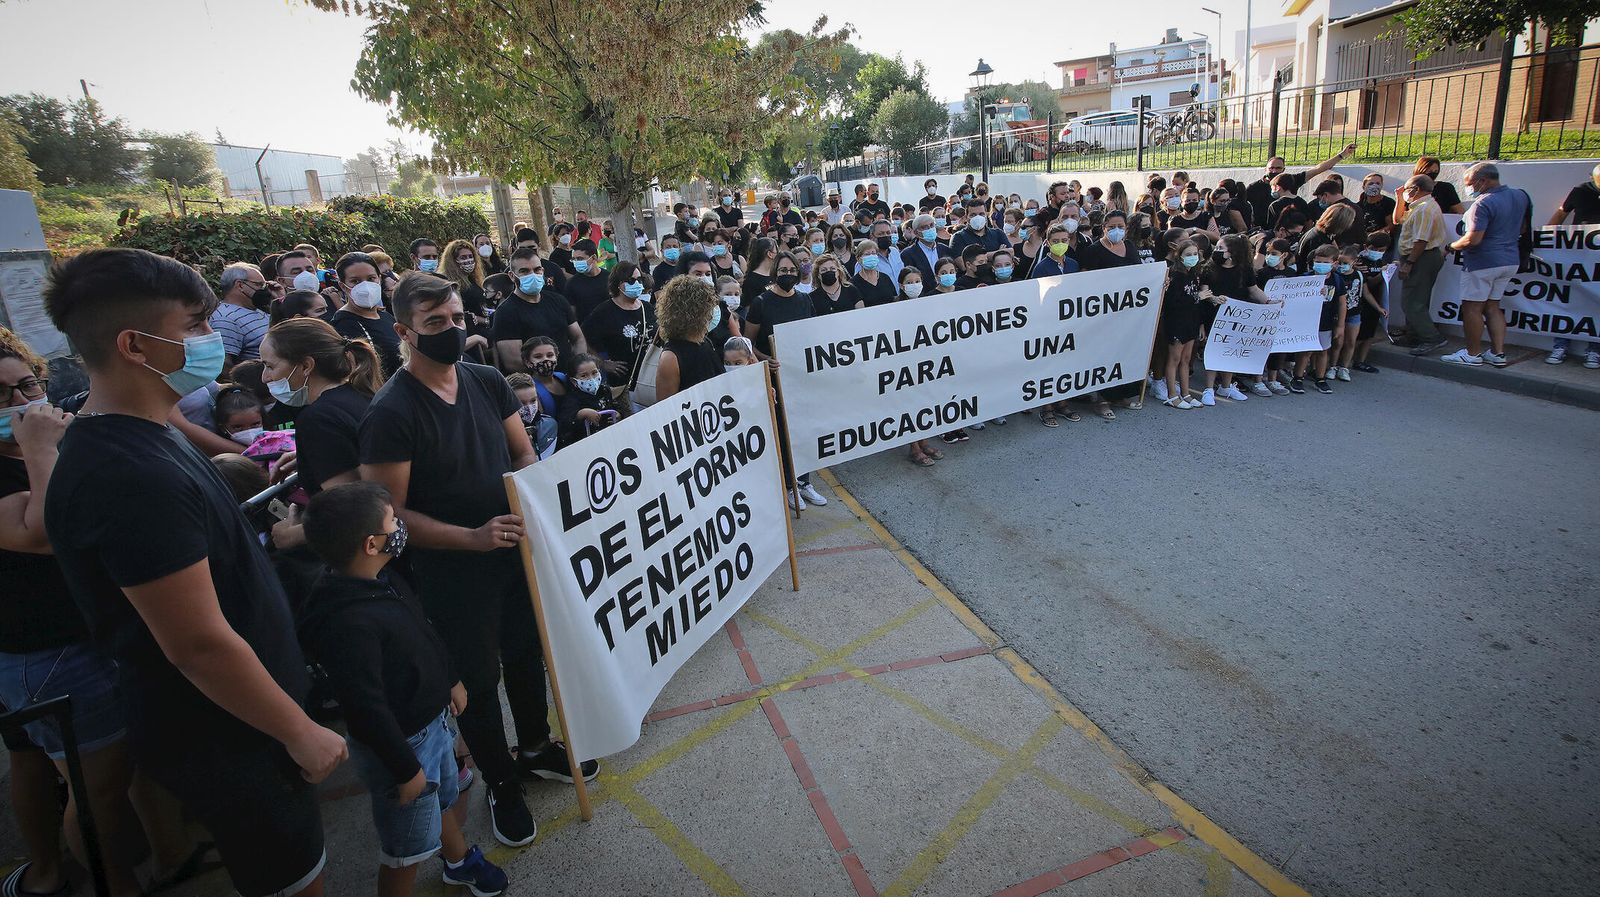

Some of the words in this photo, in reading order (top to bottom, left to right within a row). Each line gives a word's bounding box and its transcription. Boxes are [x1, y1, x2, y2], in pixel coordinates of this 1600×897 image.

[804, 305, 1029, 374] INSTALACIONES
[1058, 286, 1151, 321] DIGNAS
[1223, 305, 1253, 320] NOS
[1228, 320, 1277, 337] TIEMPO
[1503, 278, 1570, 303] CON
[878, 355, 956, 396] PARA
[1023, 332, 1076, 361] UNA
[1213, 333, 1233, 344] DE
[817, 394, 979, 460] EDUCACIÓN
[1021, 362, 1123, 402] SEGURA
[556, 447, 642, 533] L@S
[649, 394, 741, 474] NIÑ@S
[569, 520, 633, 600] DE
[636, 492, 684, 552] EL
[676, 425, 766, 511] TORNO
[593, 491, 752, 654] TENEMOS
[645, 542, 754, 668] MIEDO
